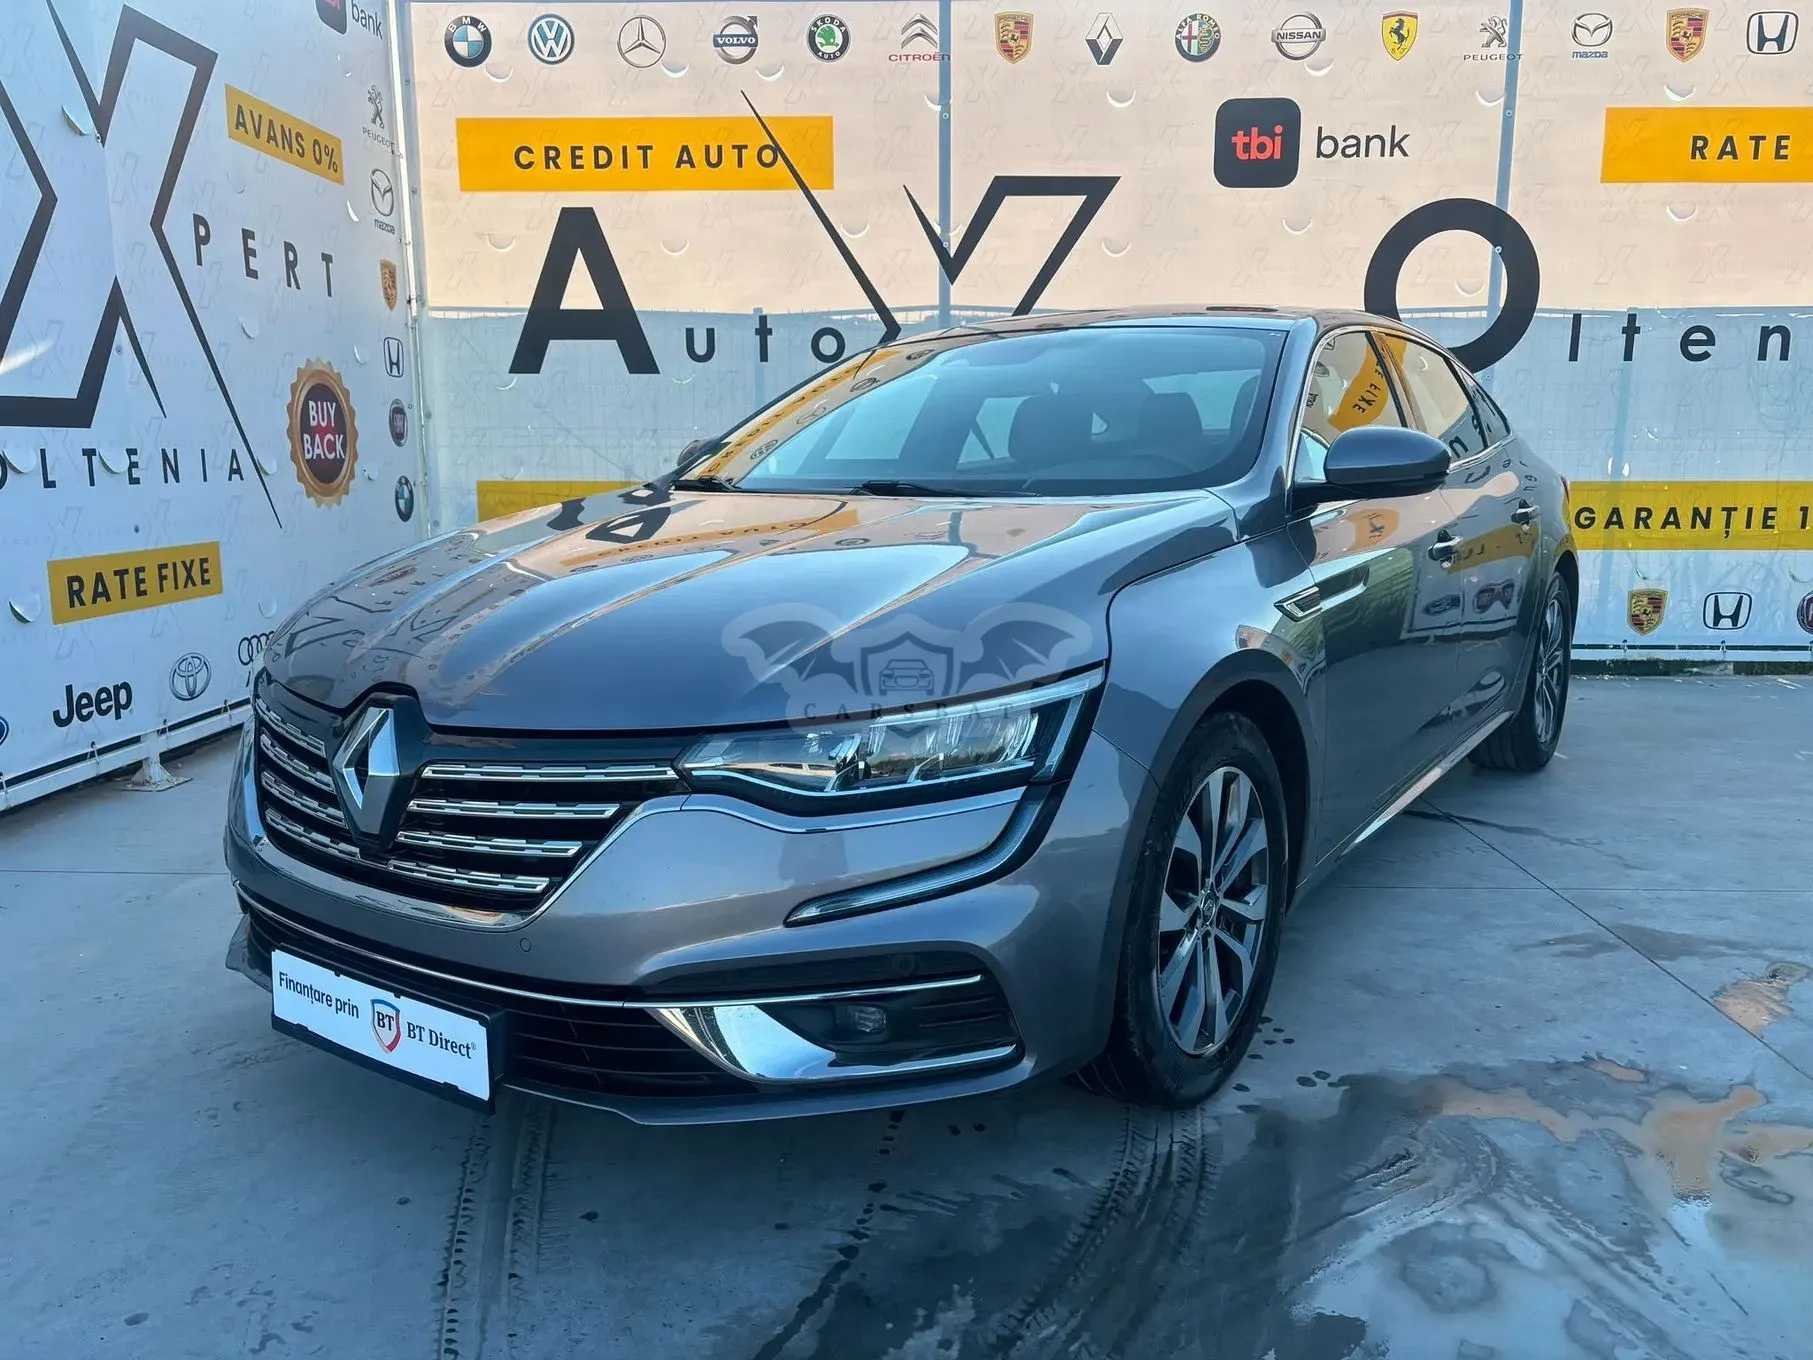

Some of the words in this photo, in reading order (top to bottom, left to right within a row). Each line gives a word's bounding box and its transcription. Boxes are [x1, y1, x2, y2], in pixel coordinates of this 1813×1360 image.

[351, 0, 383, 39] bank
[448, 16, 486, 32] BMW
[1176, 17, 1193, 40] ALFA
[1196, 14, 1220, 40] ROMEO
[715, 36, 756, 45] VOLVO
[1276, 31, 1321, 40] NISSAN
[235, 103, 305, 158] AVANS
[312, 138, 338, 173] 0%
[1232, 125, 1283, 160] tbi
[1316, 125, 1410, 159] bank
[1690, 135, 1791, 160] RATE
[514, 145, 654, 169] CREDIT
[675, 144, 780, 168] AUTO
[309, 400, 336, 428] BUY
[303, 433, 345, 460] BACK
[1574, 506, 1779, 538] GARANȚIE
[67, 566, 148, 609] RATE
[157, 557, 211, 593] FIXE
[52, 681, 133, 728] Jeep
[334, 996, 360, 1019] prin
[376, 1010, 395, 1032] BT
[406, 1021, 426, 1043] BT
